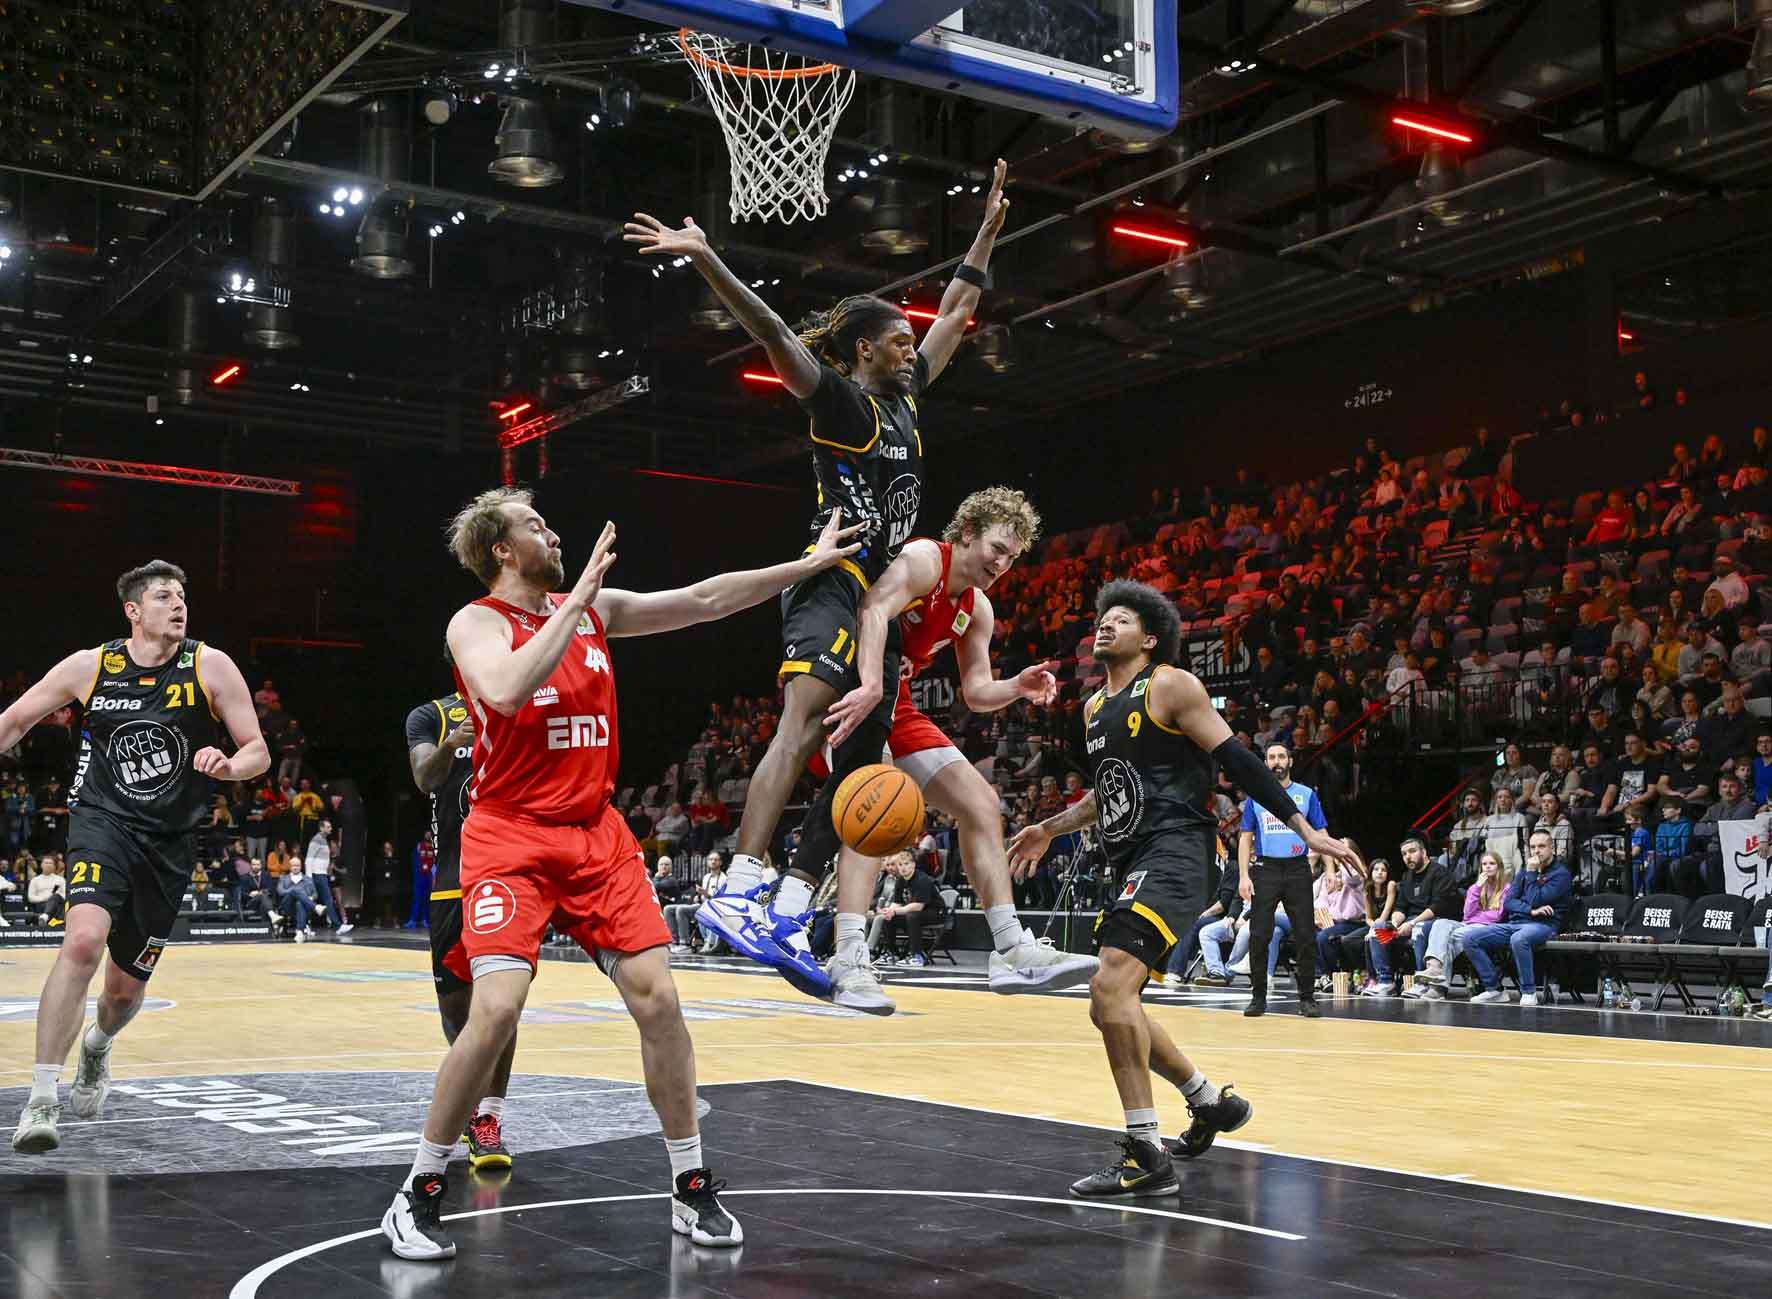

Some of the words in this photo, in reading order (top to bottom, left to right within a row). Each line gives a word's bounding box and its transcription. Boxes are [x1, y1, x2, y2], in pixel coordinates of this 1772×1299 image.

[1354, 394, 1366, 408] 24
[1371, 390, 1384, 403] 22
[165, 682, 195, 708] 21
[533, 685, 558, 698] AVIA
[90, 696, 142, 711] Bona
[1127, 711, 1141, 737] 9
[113, 727, 166, 761] KREIS
[1086, 735, 1106, 755] ona
[120, 750, 173, 785] BAU
[70, 861, 101, 885] 21
[70, 887, 95, 895] Kempa
[1587, 908, 1614, 917] BEISSE
[1644, 908, 1672, 919] BEISSE
[1704, 909, 1733, 920] BEISSE
